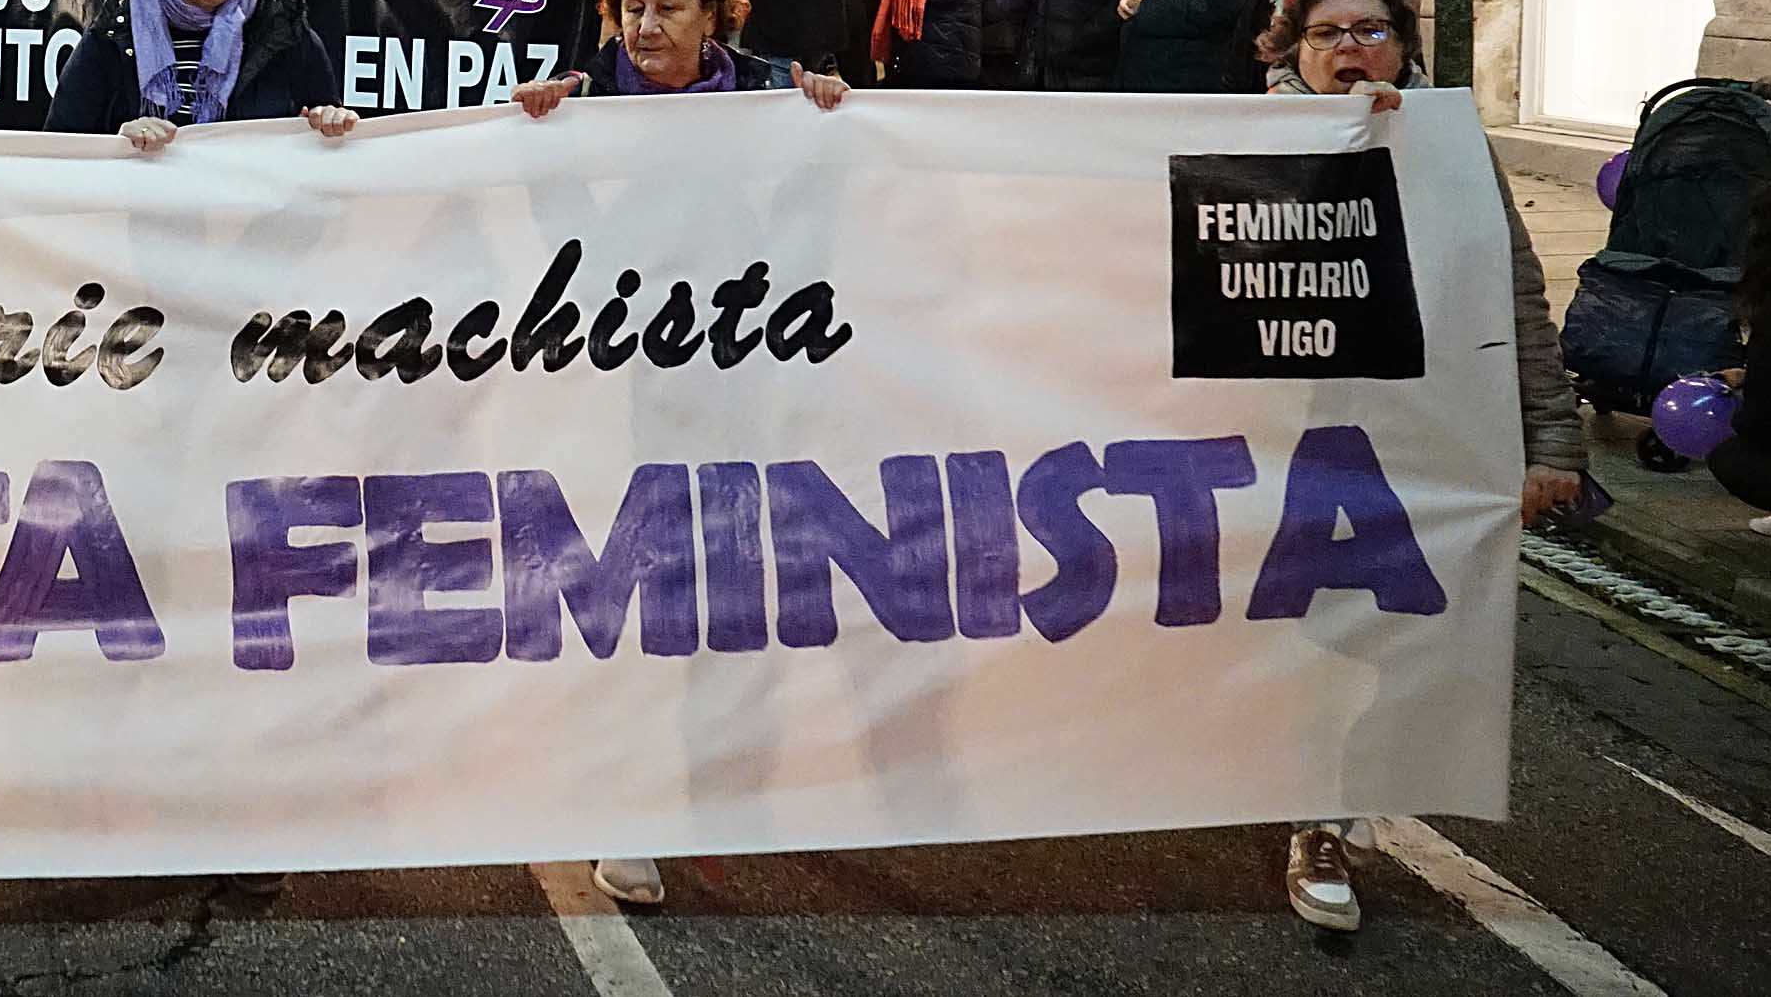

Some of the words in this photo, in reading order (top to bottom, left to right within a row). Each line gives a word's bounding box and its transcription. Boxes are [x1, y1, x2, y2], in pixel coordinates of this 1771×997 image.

[343, 35, 426, 110] EN
[1197, 197, 1378, 242] FEMINISMO
[1220, 258, 1371, 299] UNITARIO
[230, 238, 853, 384] machista
[1256, 318, 1336, 357] VIGO
[225, 424, 1449, 671] FEMINISTA
